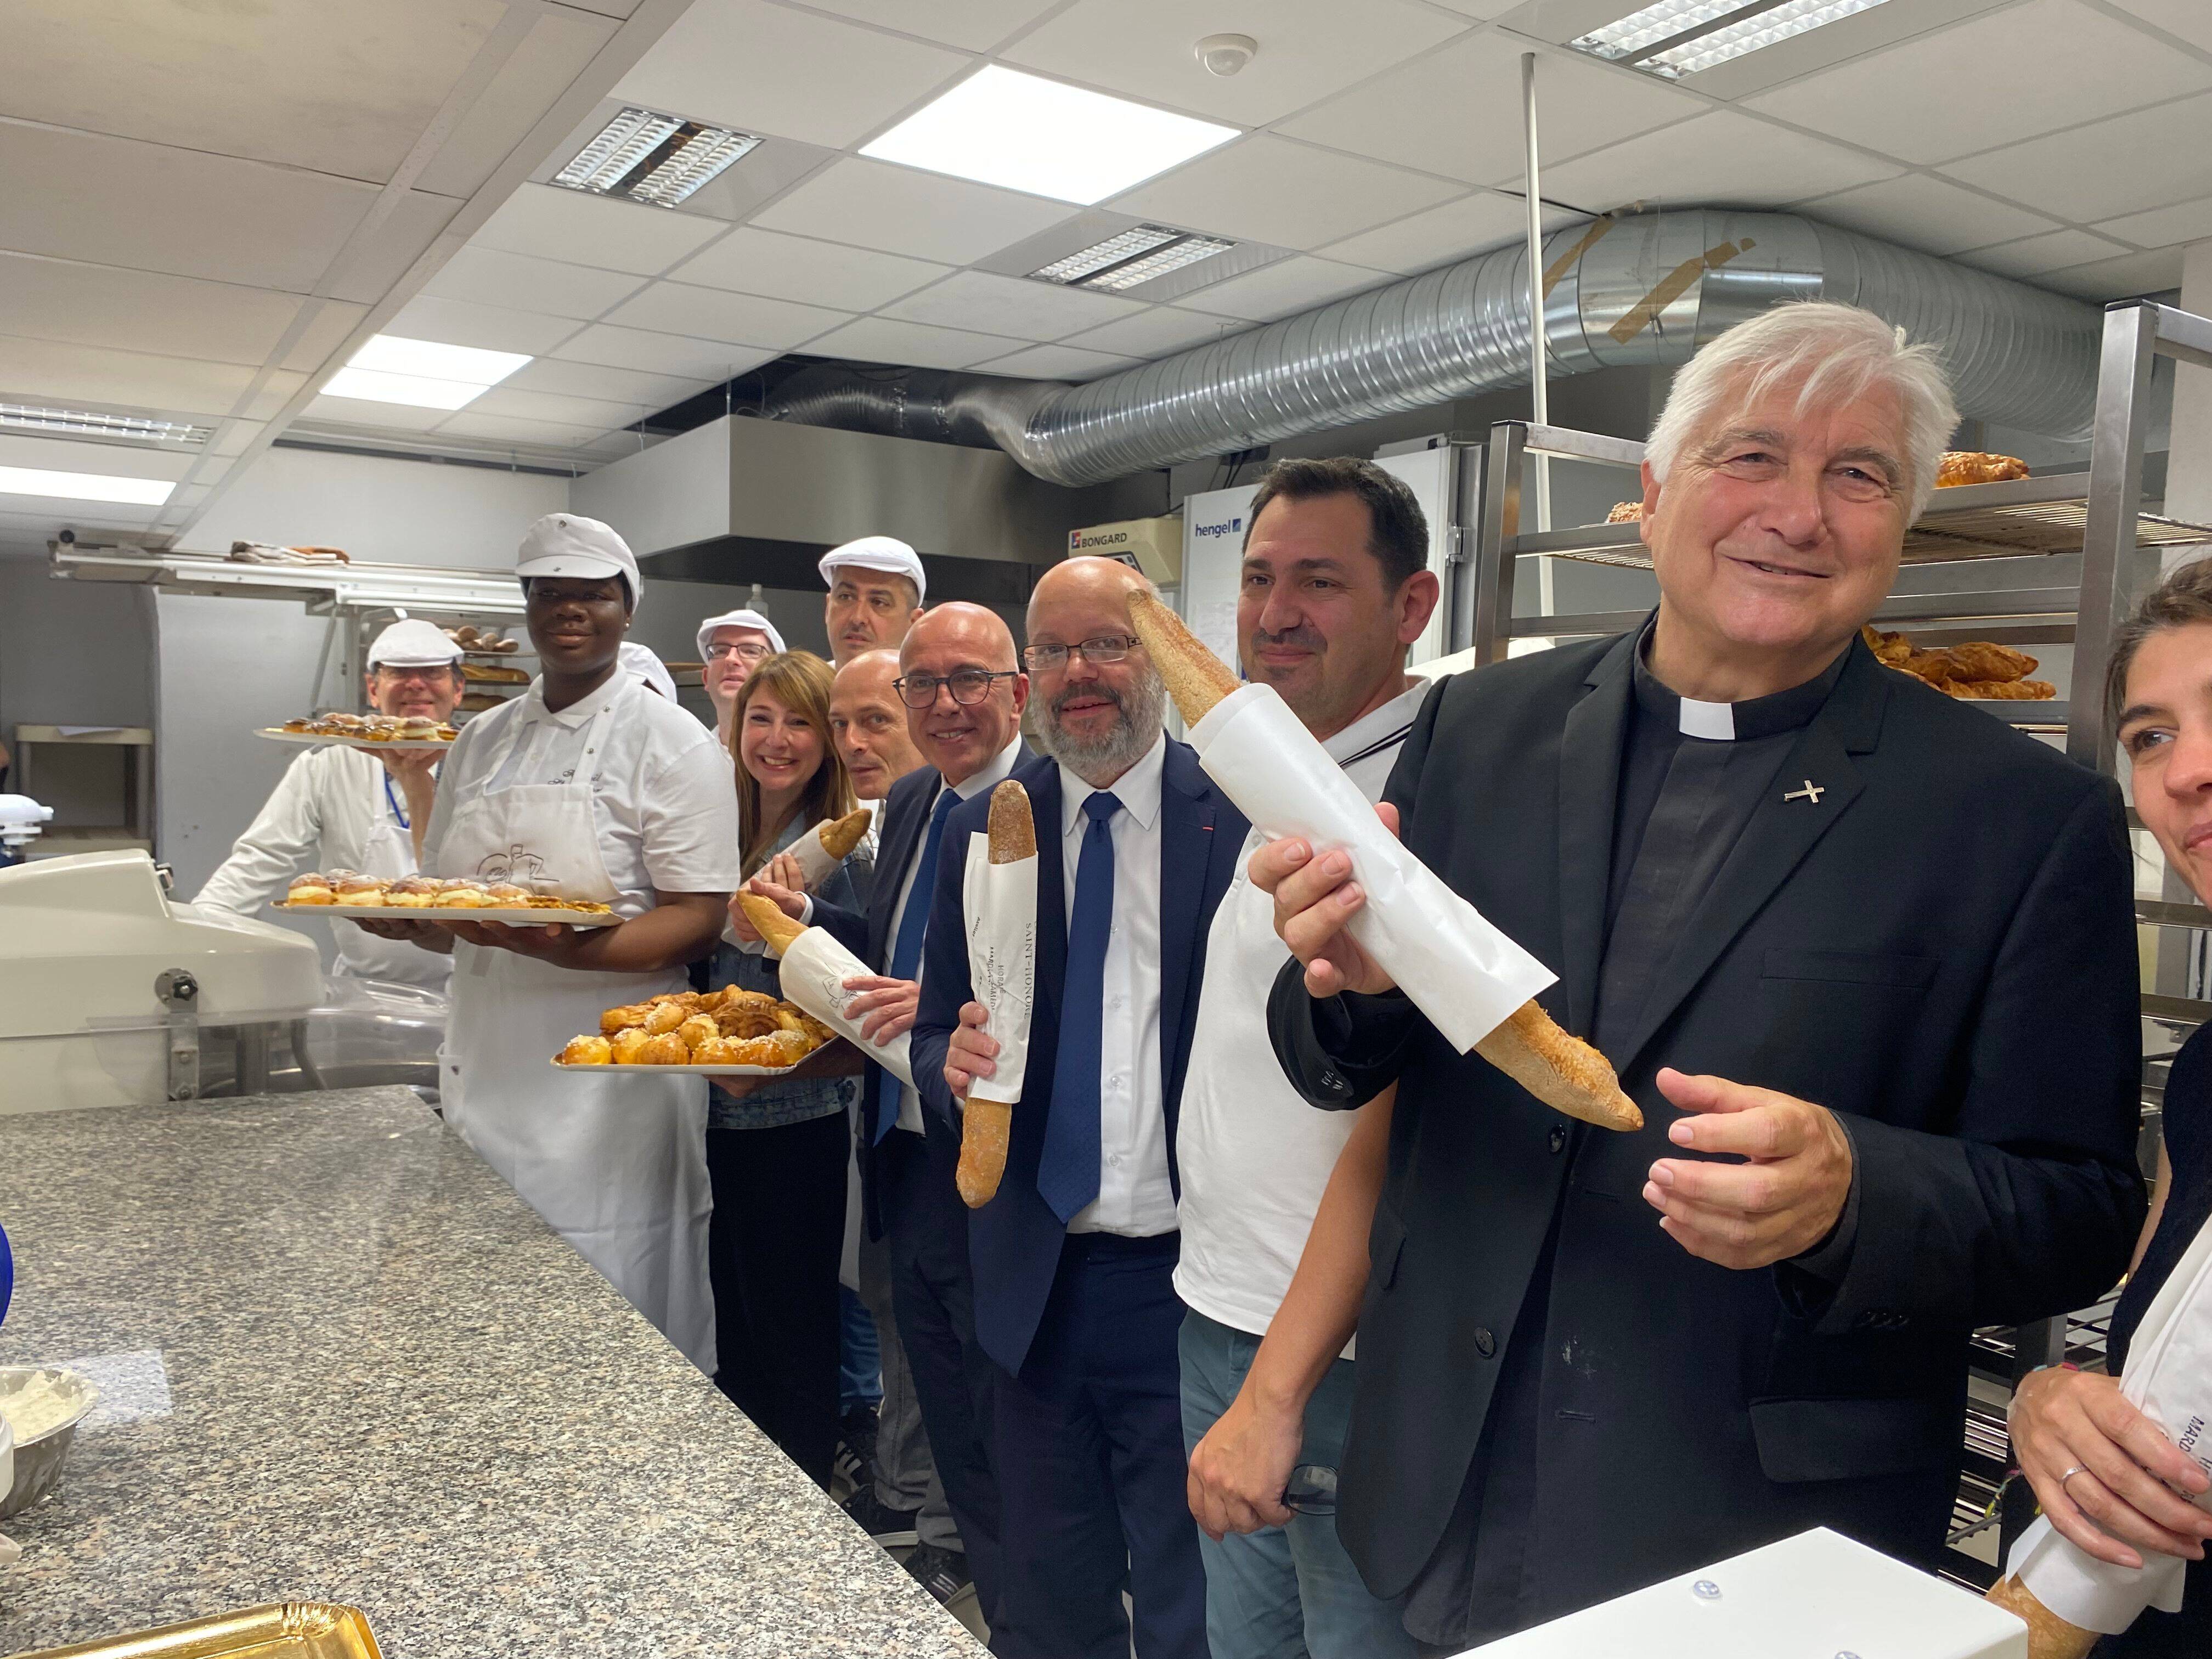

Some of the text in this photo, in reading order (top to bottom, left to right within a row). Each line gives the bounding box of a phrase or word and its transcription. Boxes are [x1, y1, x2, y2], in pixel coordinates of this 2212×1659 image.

[1195, 520, 1231, 538] hengel
[1081, 532, 1127, 548] BONGARD
[2179, 1416, 2204, 1452] MARD
